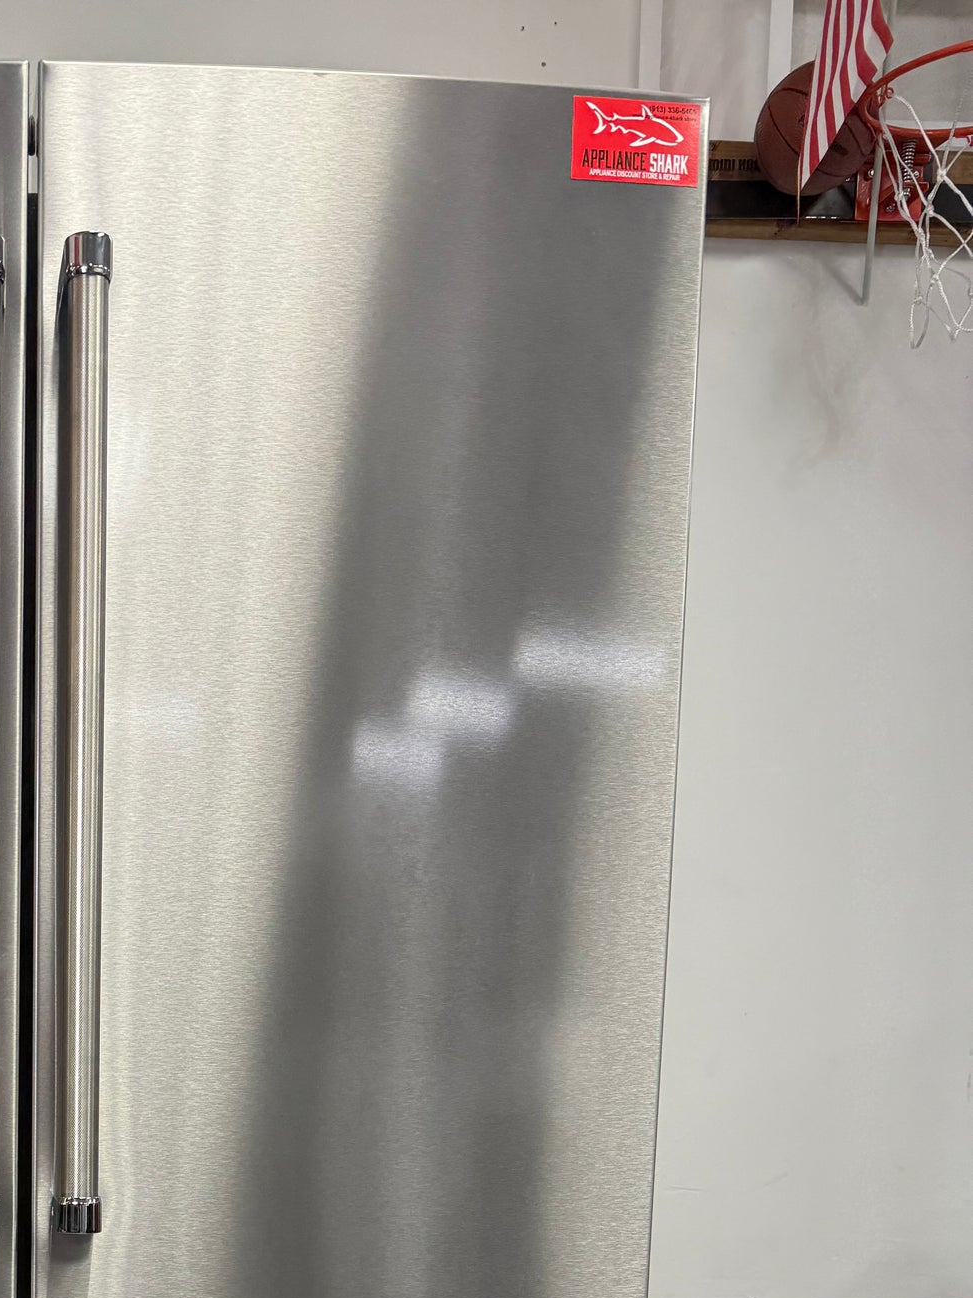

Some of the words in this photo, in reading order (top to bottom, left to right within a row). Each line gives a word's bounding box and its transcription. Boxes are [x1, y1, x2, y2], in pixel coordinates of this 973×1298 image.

[582, 149, 647, 171] APPLIANCE
[649, 153, 689, 175] SHARK
[589, 168, 616, 177] APPLIANCE
[616, 170, 641, 178] DISCOUNT
[642, 172, 658, 180] STORE
